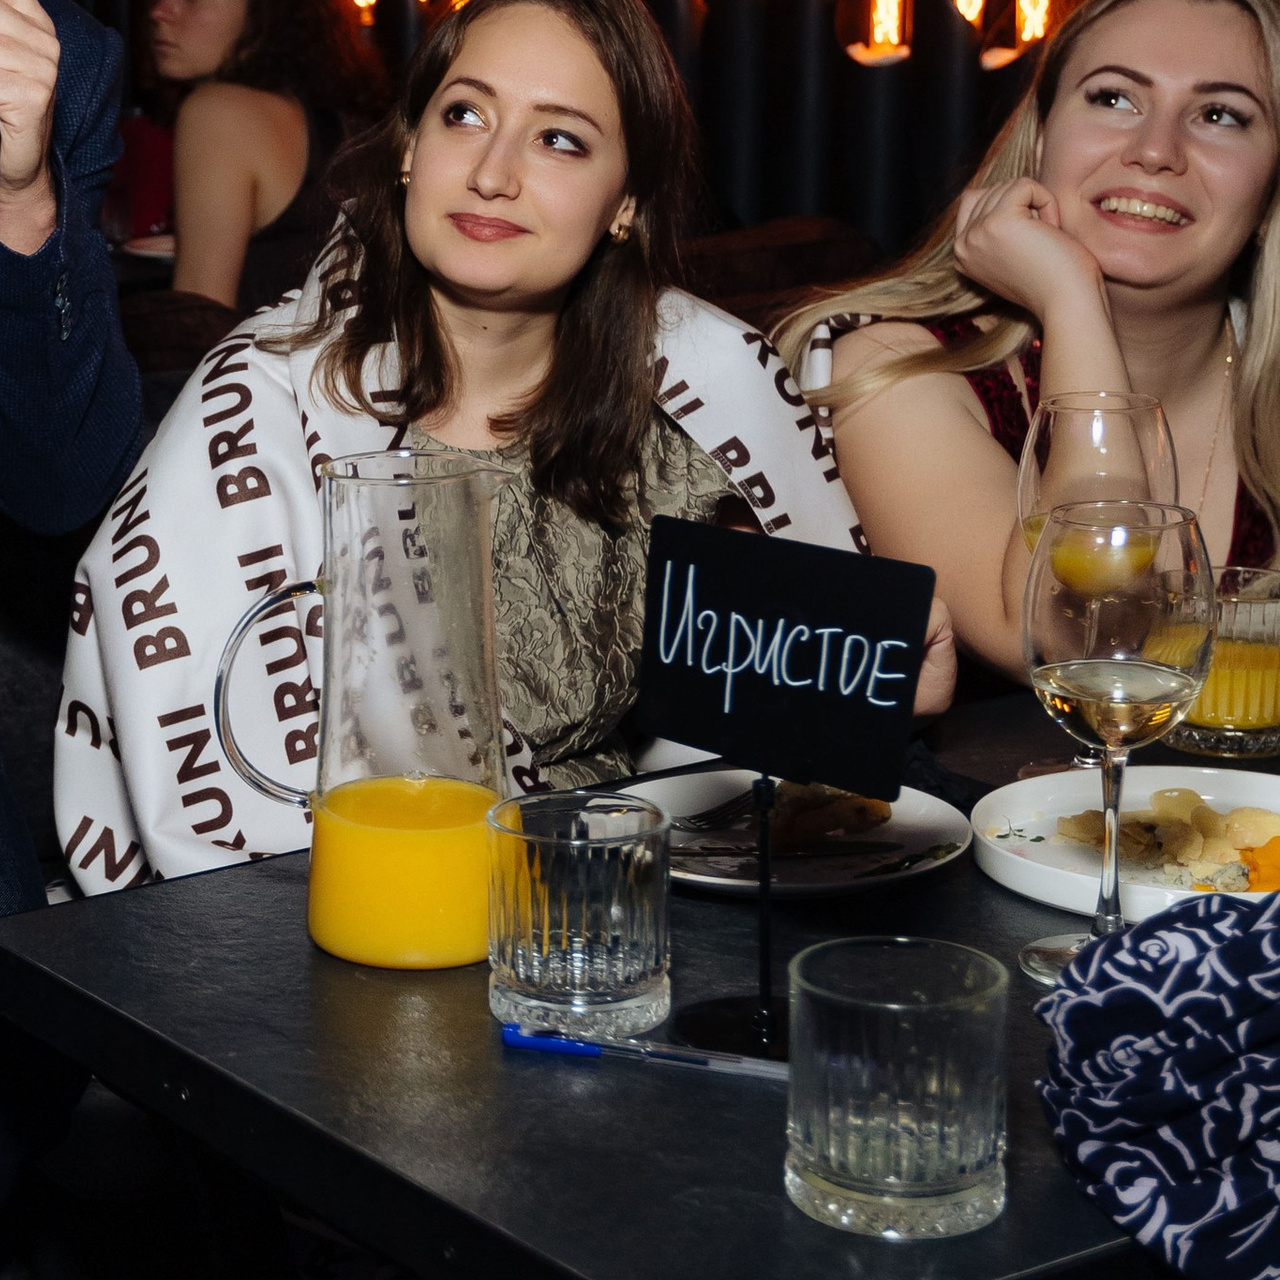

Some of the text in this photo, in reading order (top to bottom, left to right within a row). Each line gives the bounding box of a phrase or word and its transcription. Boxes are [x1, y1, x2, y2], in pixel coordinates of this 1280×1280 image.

[201, 332, 272, 510] BRUNI
[112, 466, 192, 671] BRUNI
[238, 542, 321, 766] BRUNI
[157, 702, 248, 857] UNI
